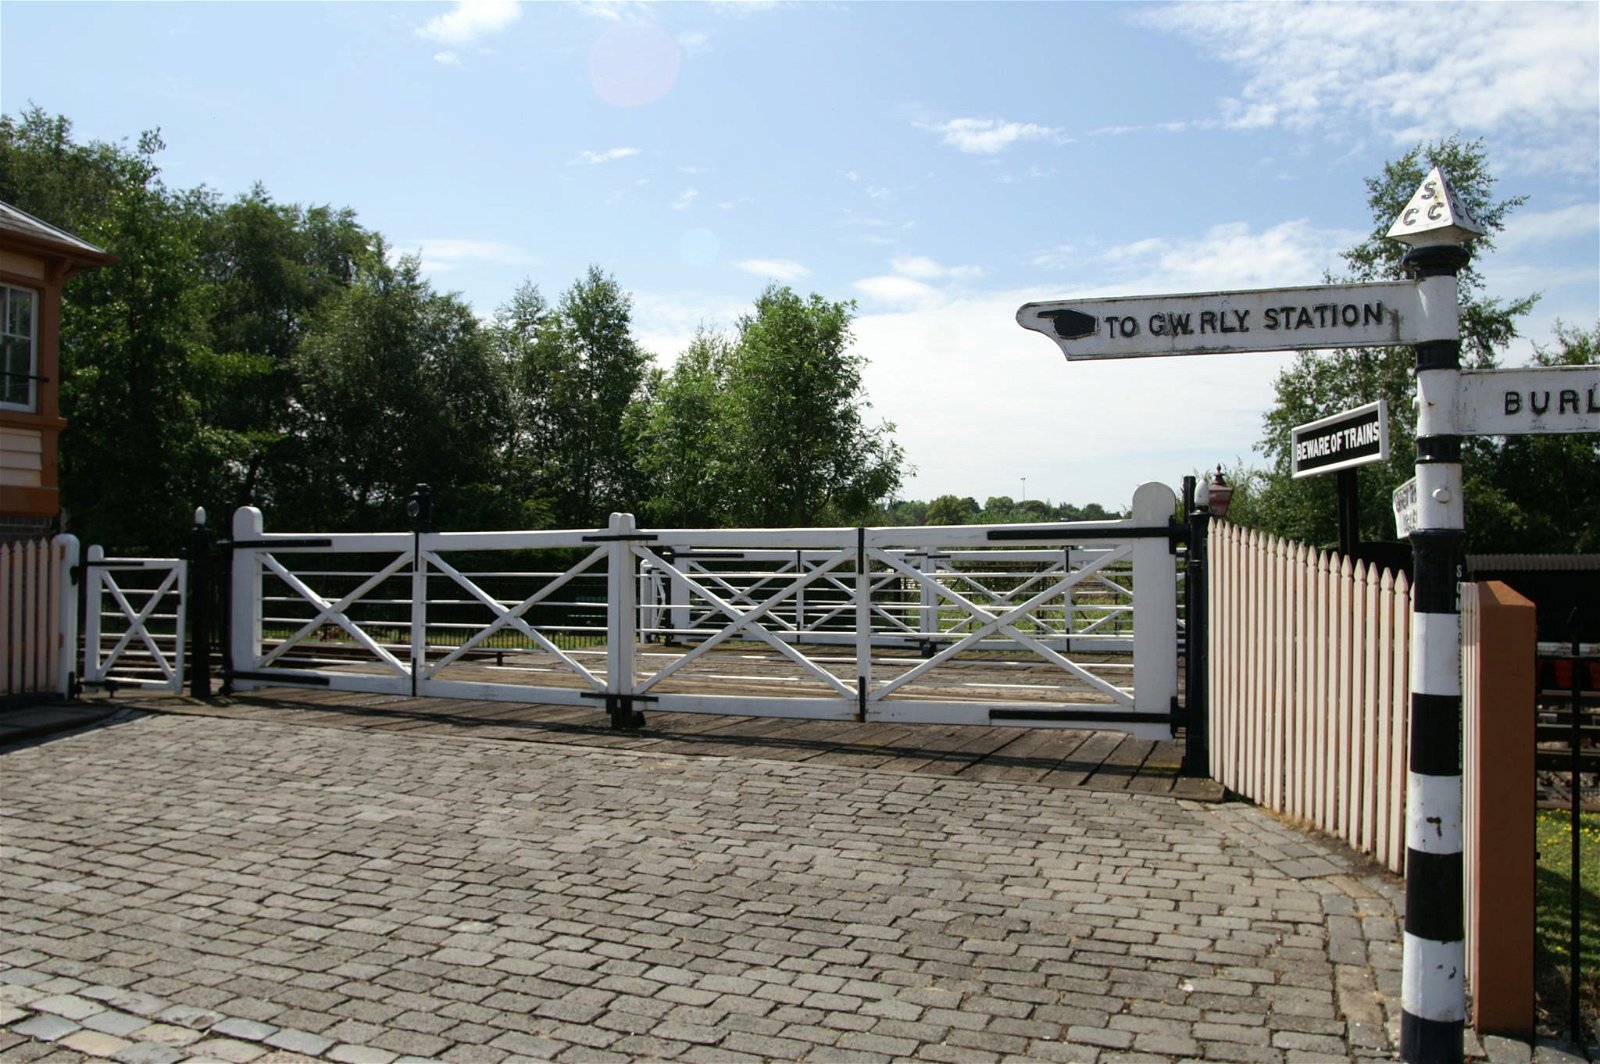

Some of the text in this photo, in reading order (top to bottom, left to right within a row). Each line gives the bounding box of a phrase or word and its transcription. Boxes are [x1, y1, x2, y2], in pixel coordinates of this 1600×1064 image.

[1421, 181, 1437, 200] S
[1104, 315, 1138, 339] TO
[1264, 301, 1382, 331] STATION
[1296, 421, 1379, 461] BEWARE OF TRAINS
